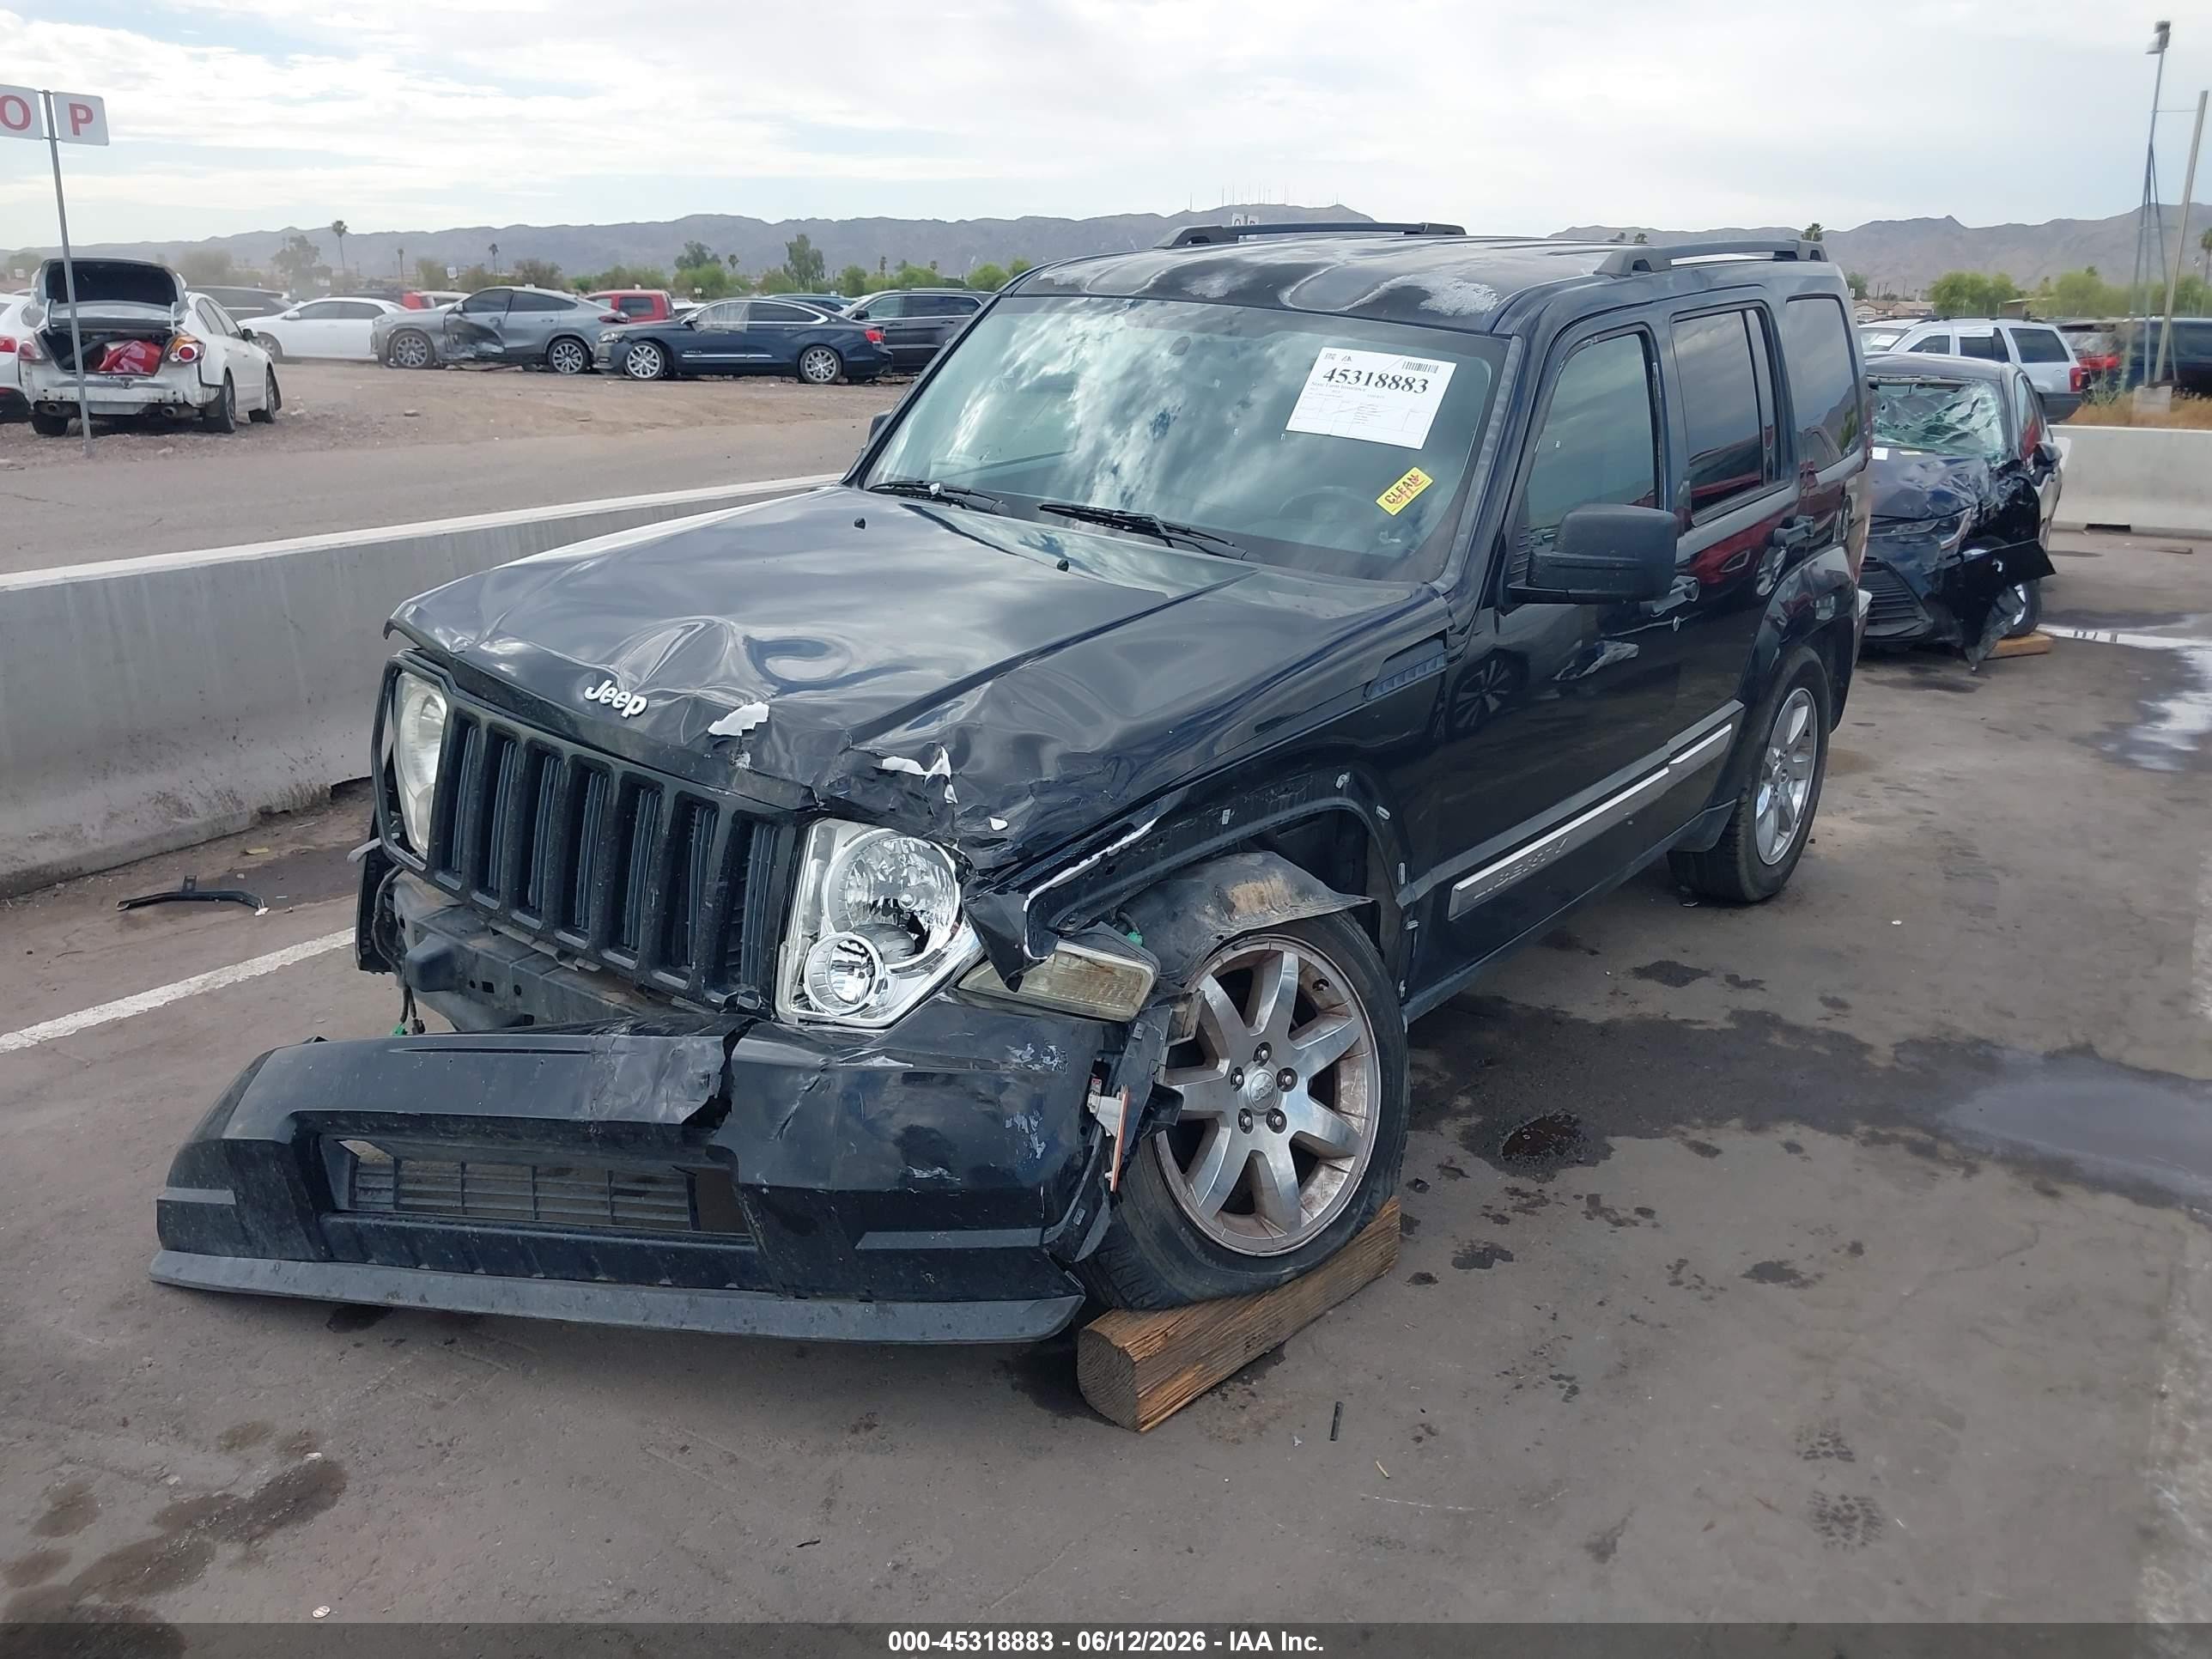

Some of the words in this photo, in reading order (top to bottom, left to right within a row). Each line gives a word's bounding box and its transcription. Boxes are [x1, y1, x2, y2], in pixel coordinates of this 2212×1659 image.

[69, 102, 94, 137] P
[1322, 367, 1429, 394] 45318883
[1384, 474, 1419, 505] CLEAN
[584, 679, 649, 719] Jeep
